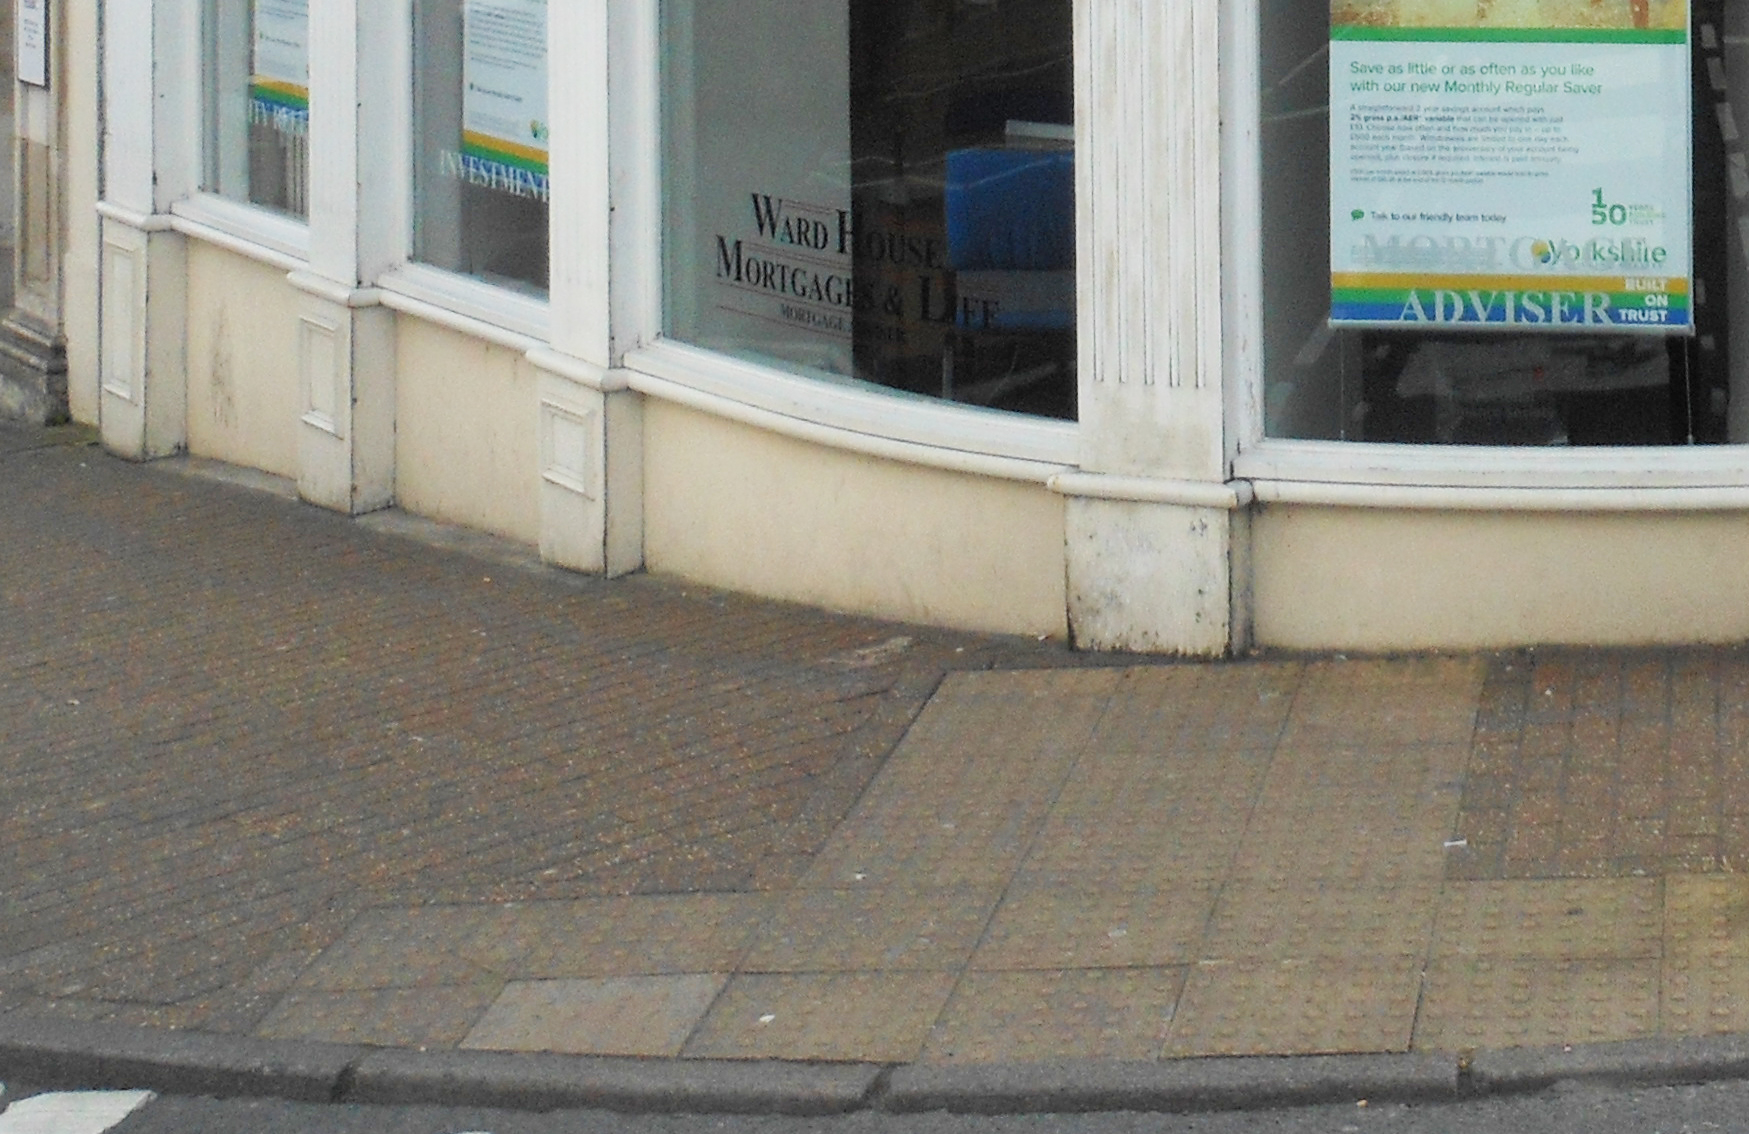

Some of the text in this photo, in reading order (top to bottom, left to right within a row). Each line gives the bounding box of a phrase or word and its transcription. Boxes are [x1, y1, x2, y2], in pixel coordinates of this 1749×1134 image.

[1350, 60, 1595, 79] Save as little or as often as you like
[1350, 78, 1603, 97] with our new Monthly Regular Saver
[752, 193, 829, 251] WARD
[1391, 211, 1400, 221] to
[1419, 211, 1453, 224] friendly
[1480, 212, 1508, 224] today
[1398, 287, 1615, 325] ADVISER
[1645, 294, 1668, 307] ON
[1618, 308, 1668, 323] TRUST
